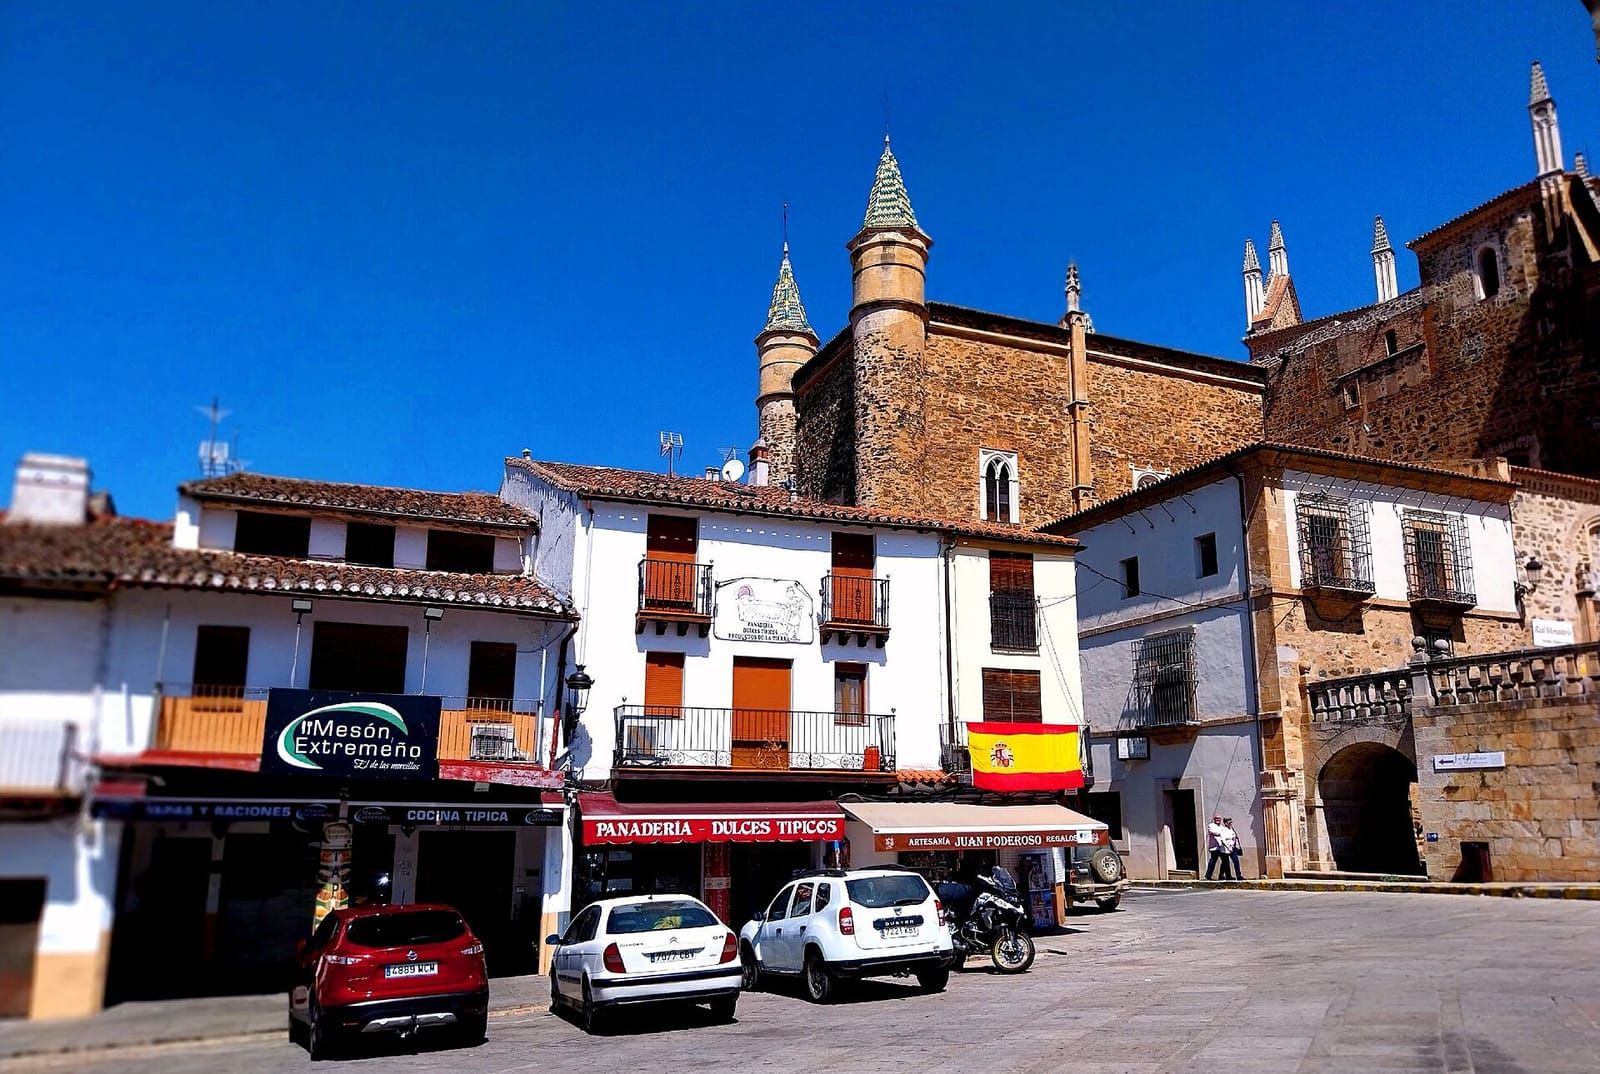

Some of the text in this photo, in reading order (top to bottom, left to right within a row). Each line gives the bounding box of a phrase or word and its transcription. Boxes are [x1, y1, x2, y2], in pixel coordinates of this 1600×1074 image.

[314, 719, 390, 740] Mesón
[295, 736, 421, 758] Extremeño
[369, 760, 379, 769] de
[379, 761, 390, 771] las
[199, 806, 209, 816] Y
[214, 806, 292, 817] RACIONES
[407, 810, 509, 822] COCINA TIPICA
[596, 820, 693, 837] PANADERÍA
[711, 820, 771, 835] DULCES
[776, 820, 838, 835] TIPICOS
[954, 835, 985, 847] JUAN
[986, 834, 1042, 847] PODEROSO
[1046, 834, 1078, 843] REGALOS
